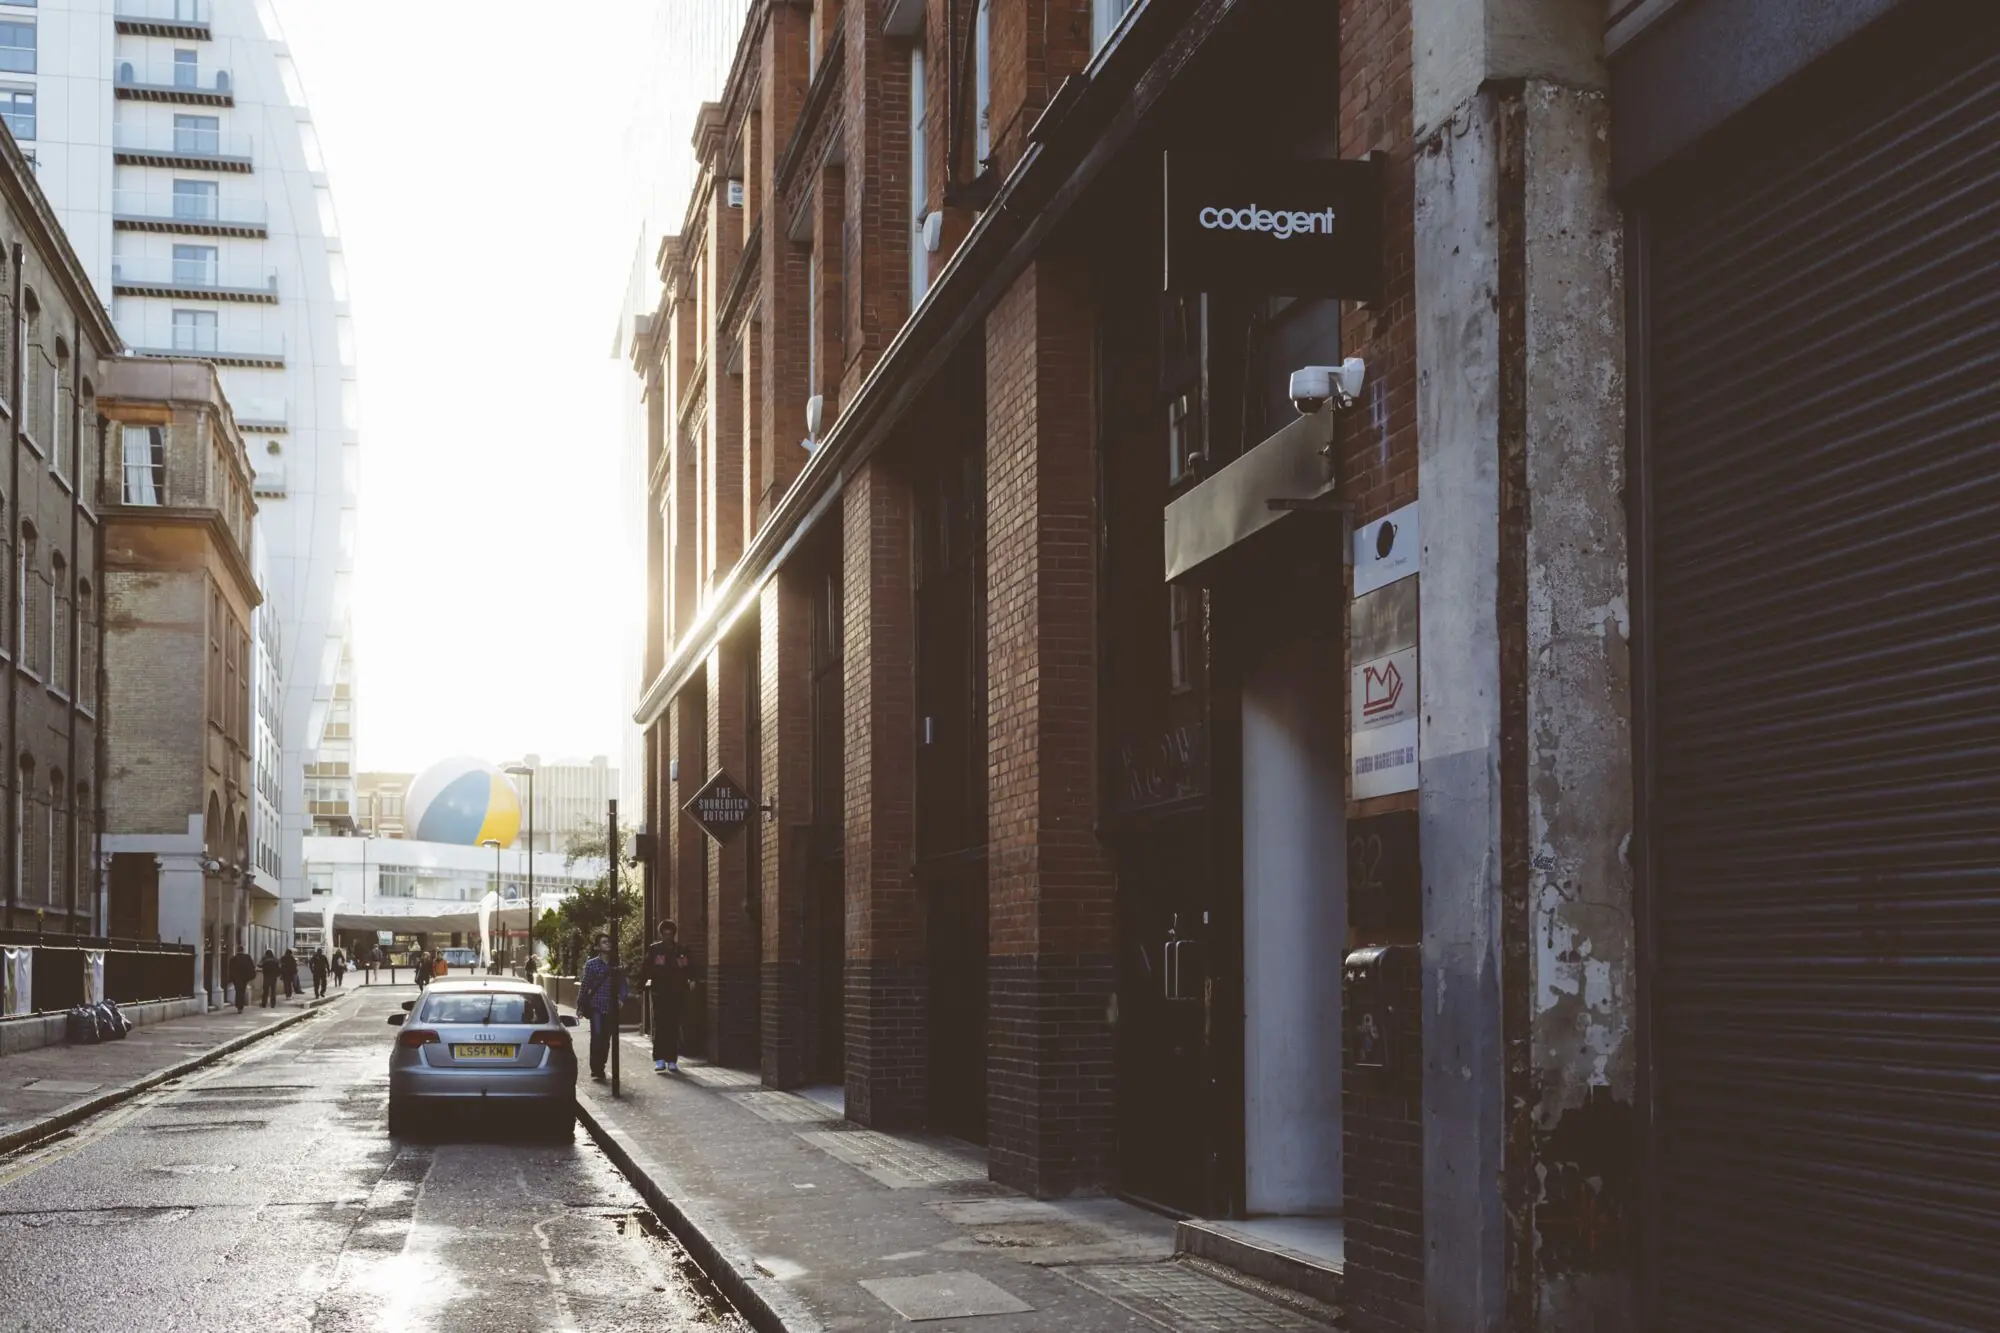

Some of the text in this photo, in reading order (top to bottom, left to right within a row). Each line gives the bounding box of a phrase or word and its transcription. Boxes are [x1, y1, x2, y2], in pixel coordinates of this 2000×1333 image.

[1200, 203, 1335, 239] codegent
[716, 787, 731, 798] THE
[698, 798, 749, 810] SHOREDITCH
[1351, 834, 1383, 889] 32
[460, 1046, 509, 1057] LS54 KMA
